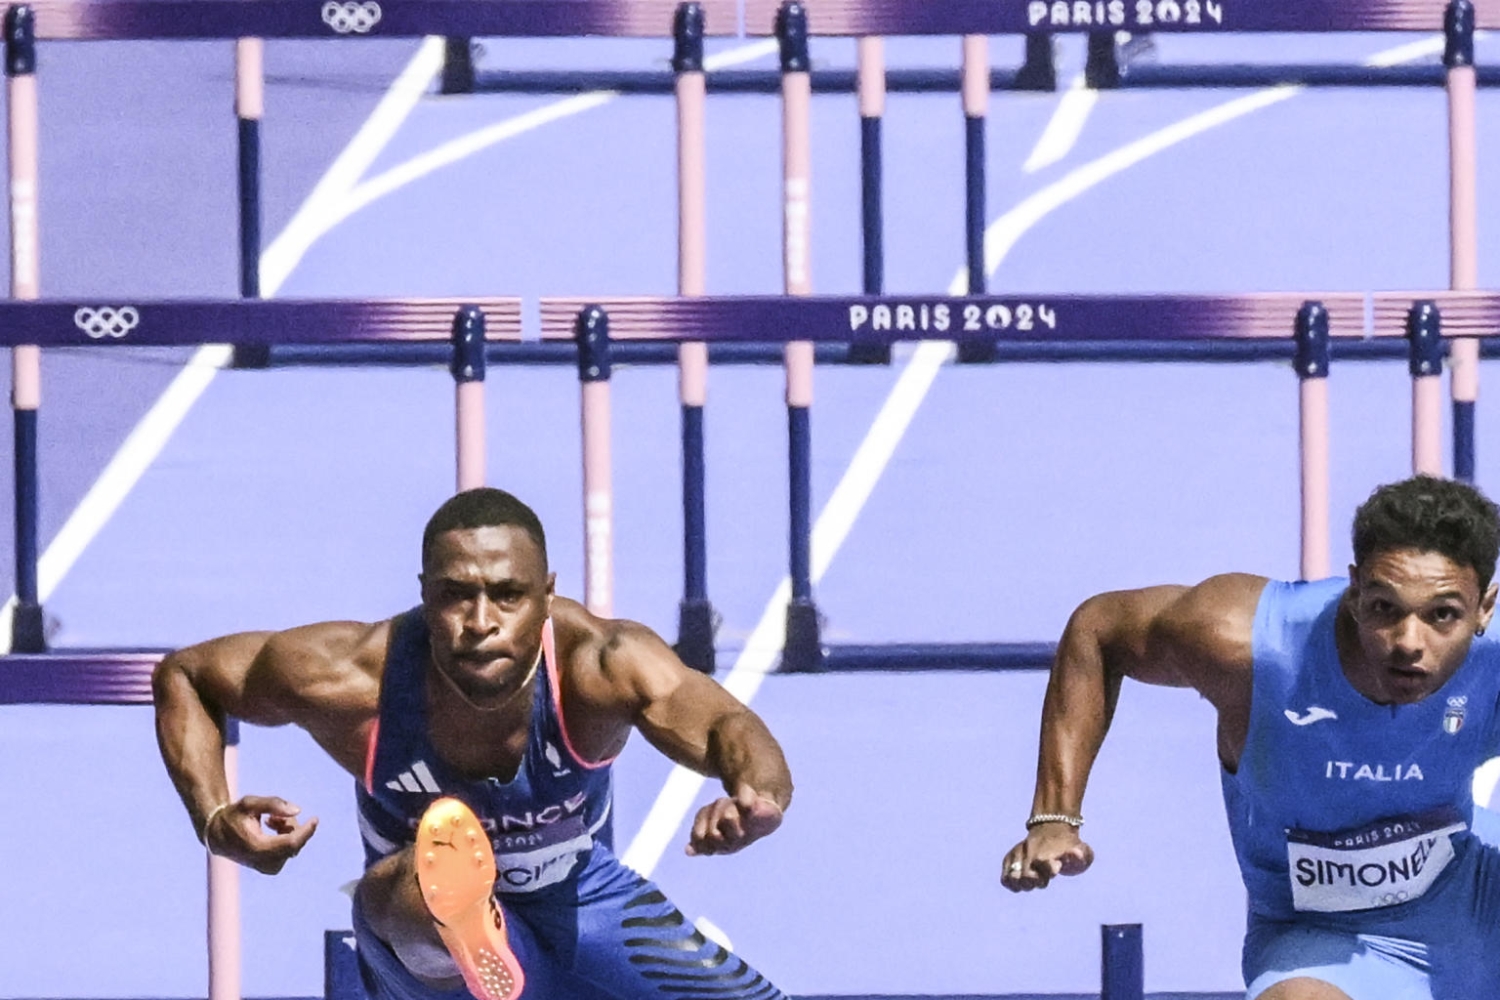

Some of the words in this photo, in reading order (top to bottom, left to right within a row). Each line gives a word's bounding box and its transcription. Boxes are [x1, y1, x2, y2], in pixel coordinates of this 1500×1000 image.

[1136, 0, 1222, 25] 2024
[963, 303, 1056, 330] 2024
[1326, 760, 1424, 782] ITALIA
